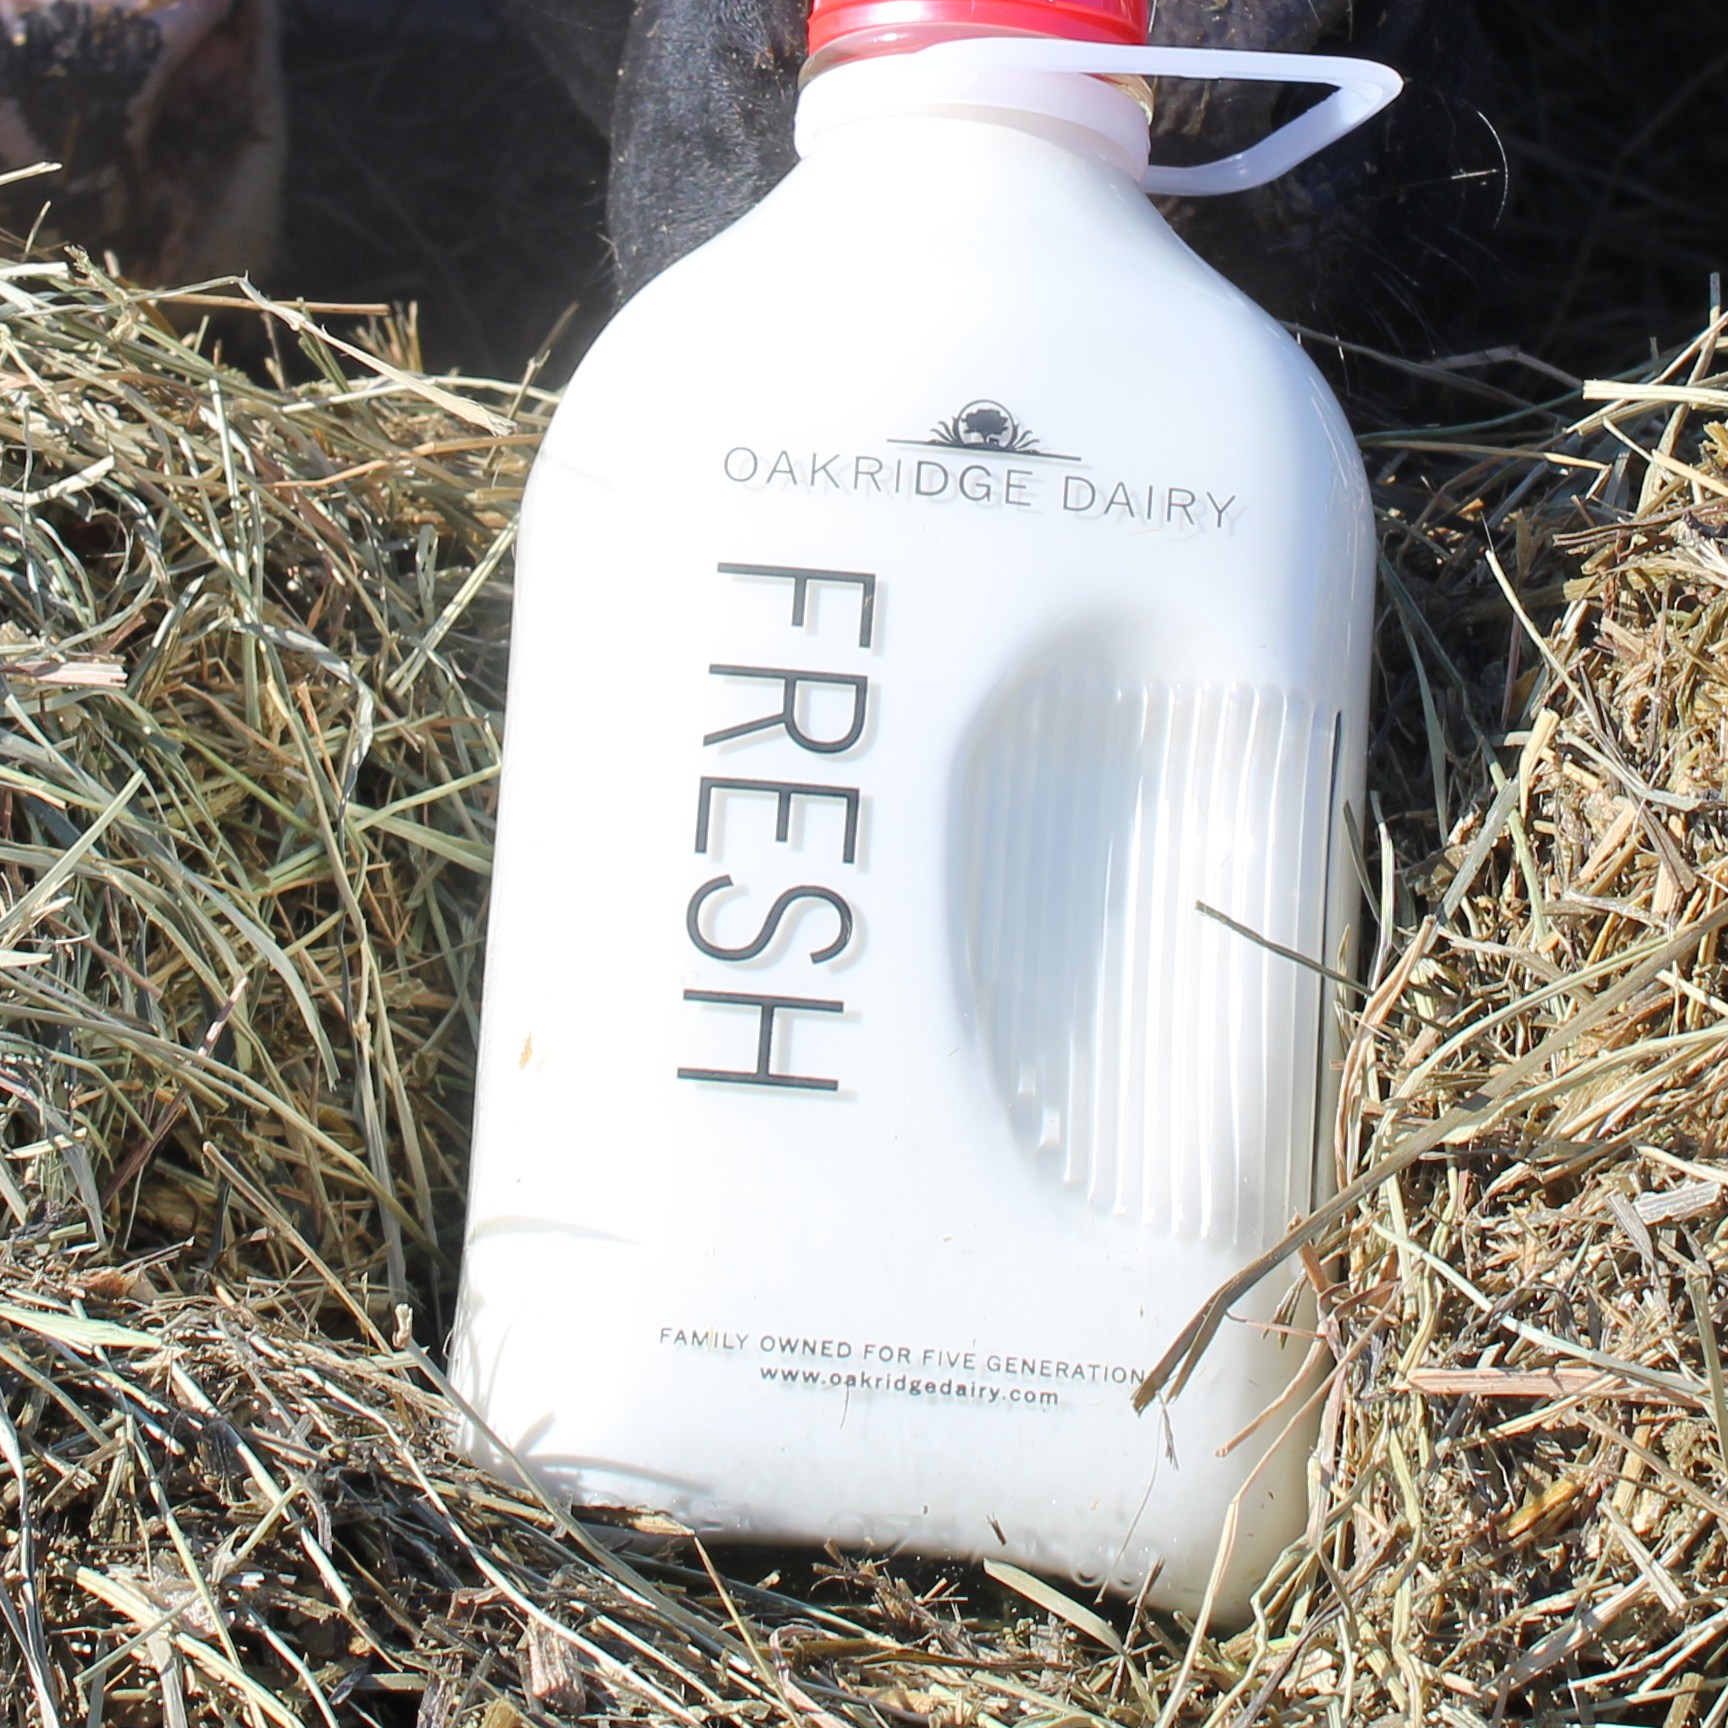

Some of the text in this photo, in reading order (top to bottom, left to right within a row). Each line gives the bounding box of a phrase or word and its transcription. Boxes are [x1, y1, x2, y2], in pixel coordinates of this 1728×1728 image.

[723, 446, 1238, 529] OAKRIDGE DAIRY
[676, 561, 877, 1092] FRESH
[659, 1327, 1160, 1386] FAMILY OWNED FOR FIVE GENERATION
[760, 1366, 1059, 1406] www.oakridgedairy.com
